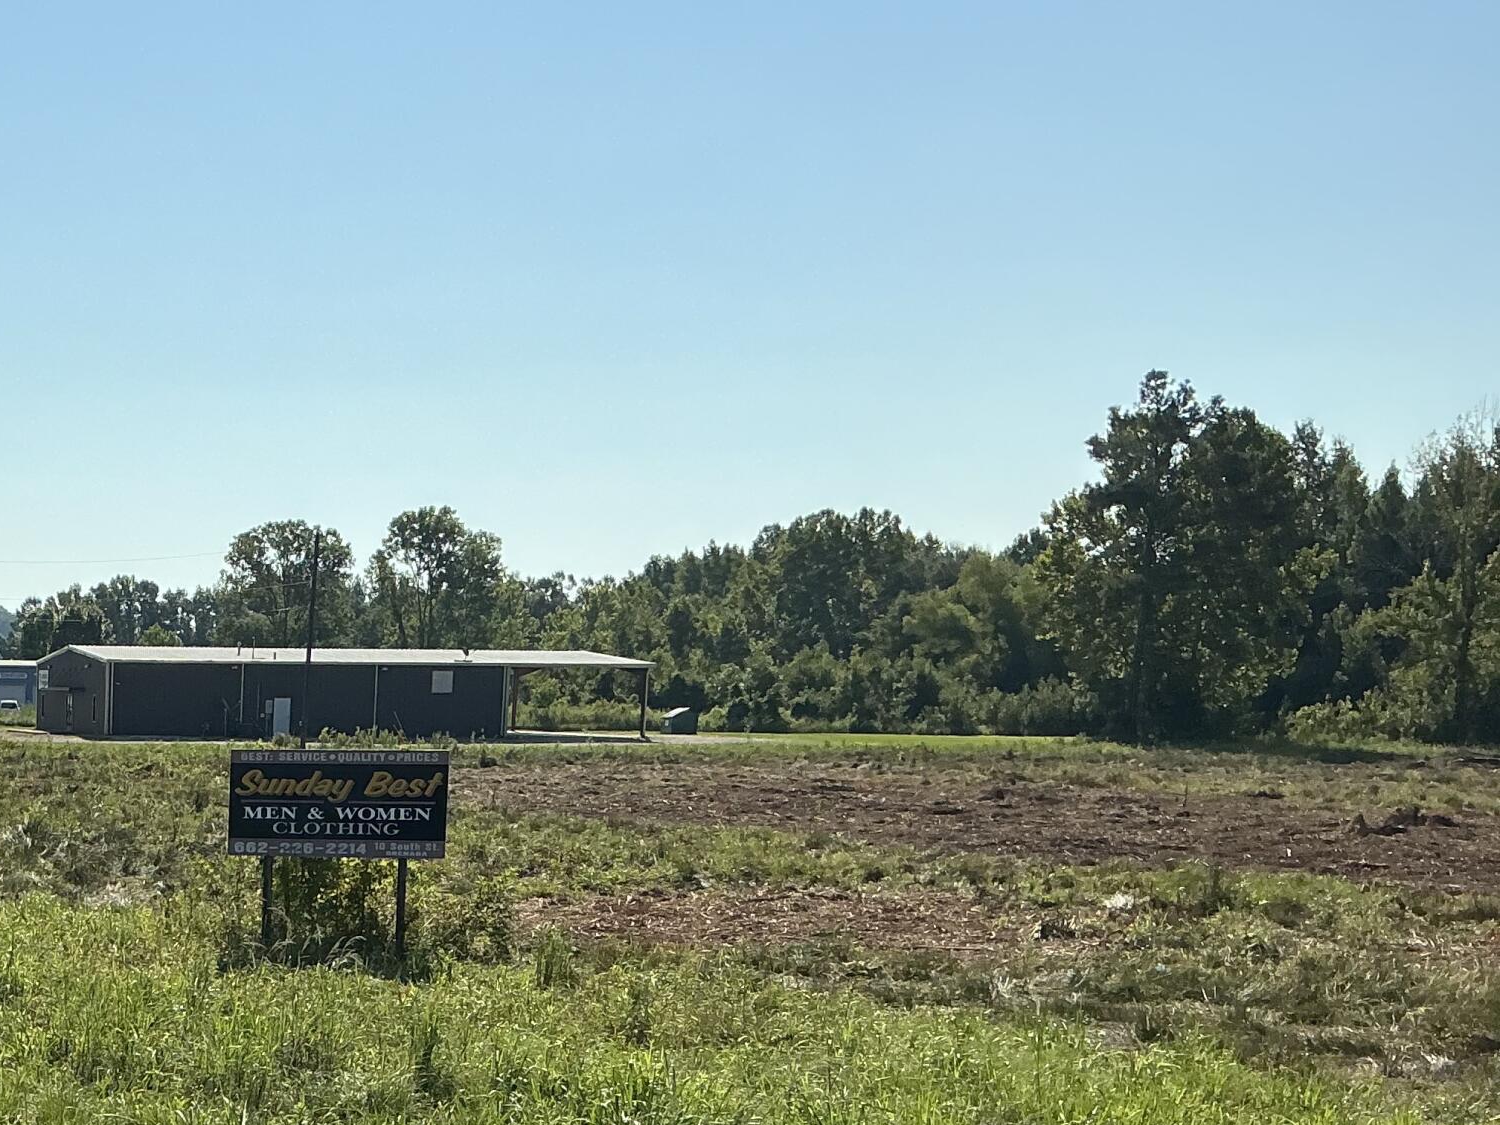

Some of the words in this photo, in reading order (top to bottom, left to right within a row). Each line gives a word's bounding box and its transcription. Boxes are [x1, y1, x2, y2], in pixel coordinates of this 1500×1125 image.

[241, 752, 273, 761] BEST:
[279, 753, 327, 761] SERVICE
[338, 753, 385, 762] QUALITY
[396, 753, 439, 762] PRICES
[235, 769, 355, 803] Sunday
[364, 771, 444, 797] Best
[242, 806, 298, 820] MEN
[307, 807, 324, 820] &
[335, 807, 431, 821] WOMEN
[272, 822, 400, 835] CLOTHING
[234, 841, 366, 855] 662-226-2214
[390, 843, 421, 851] South
